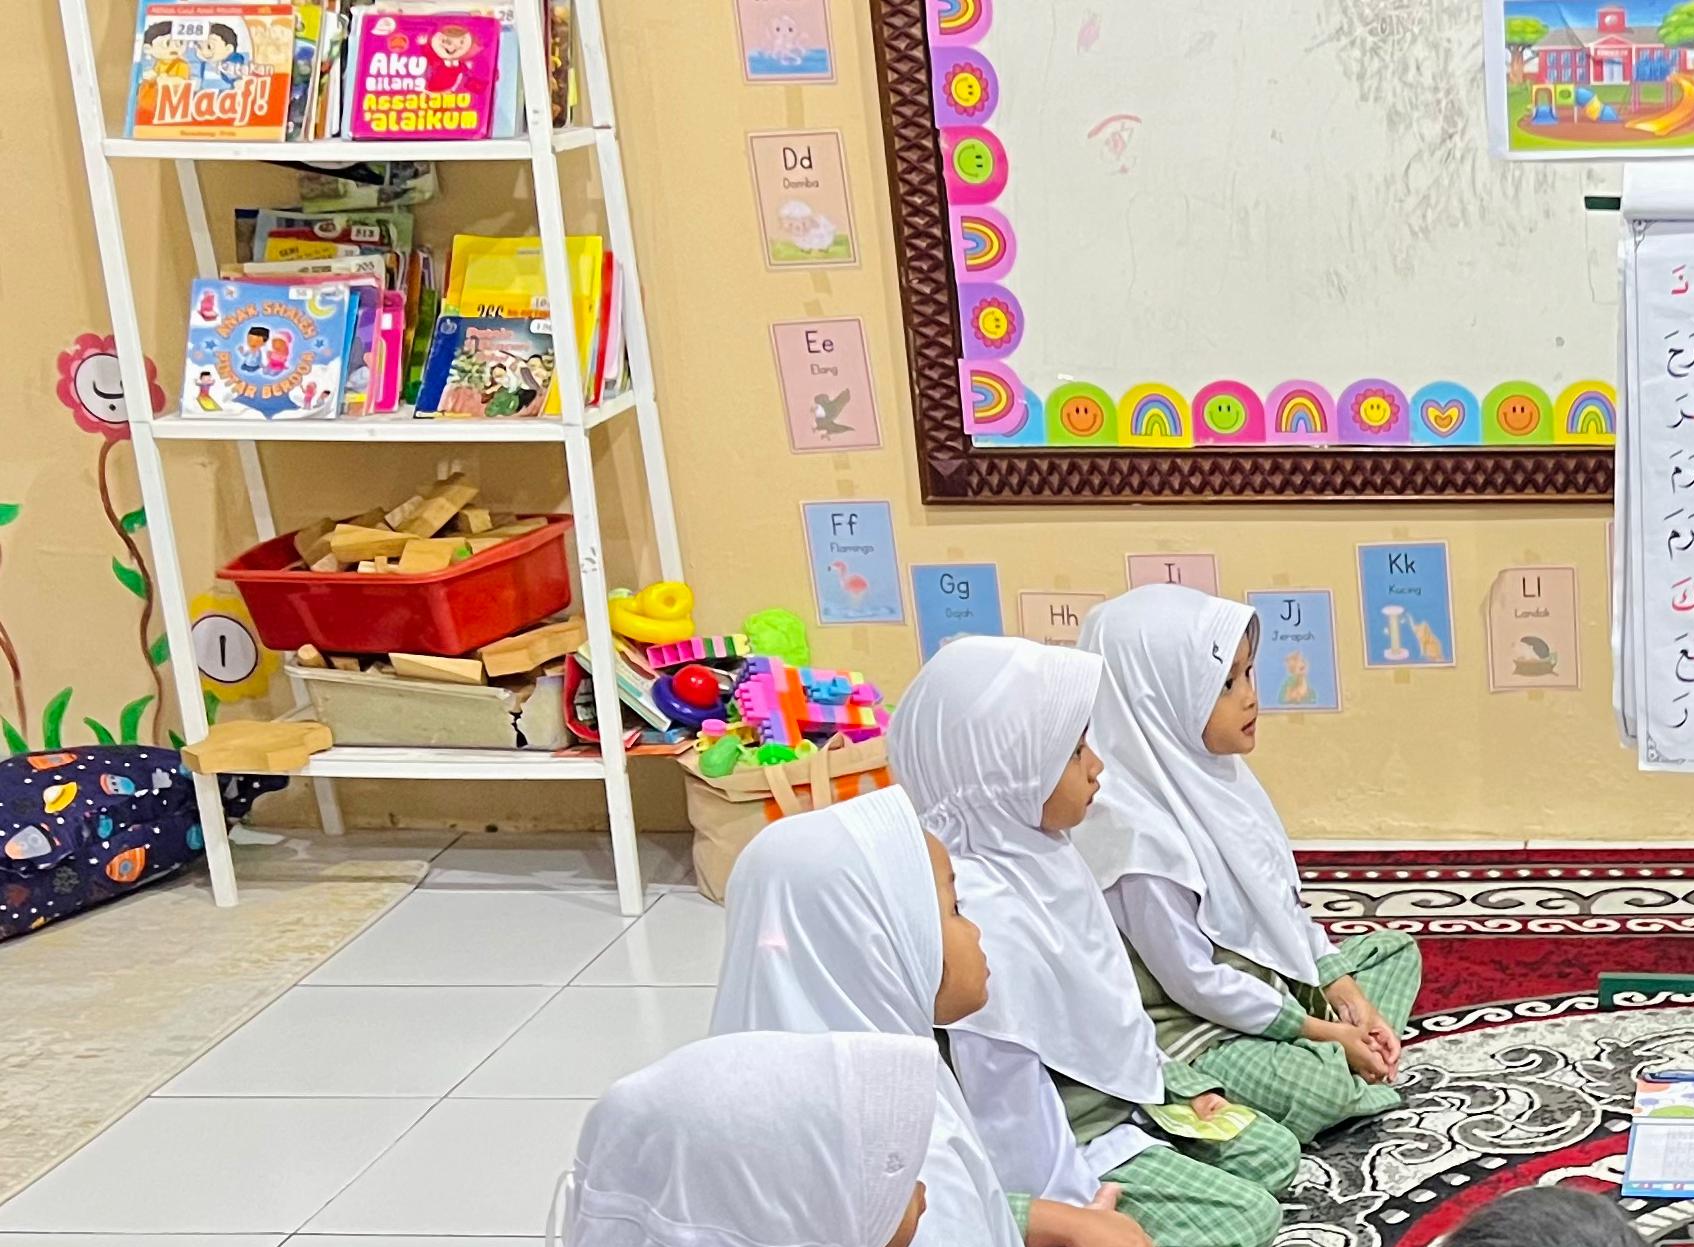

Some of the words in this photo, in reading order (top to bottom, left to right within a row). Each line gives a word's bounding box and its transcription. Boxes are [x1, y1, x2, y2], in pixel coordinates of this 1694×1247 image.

[176, 23, 204, 36] 288
[153, 75, 272, 126] Maaf!
[782, 145, 813, 171] Dd
[805, 330, 835, 354] Ee
[831, 513, 858, 536] Ff
[1388, 553, 1416, 575] Kk
[939, 573, 970, 600] Gg
[1522, 576, 1541, 598] Ll
[1050, 604, 1079, 626] Hh
[1280, 599, 1302, 627] Jj
